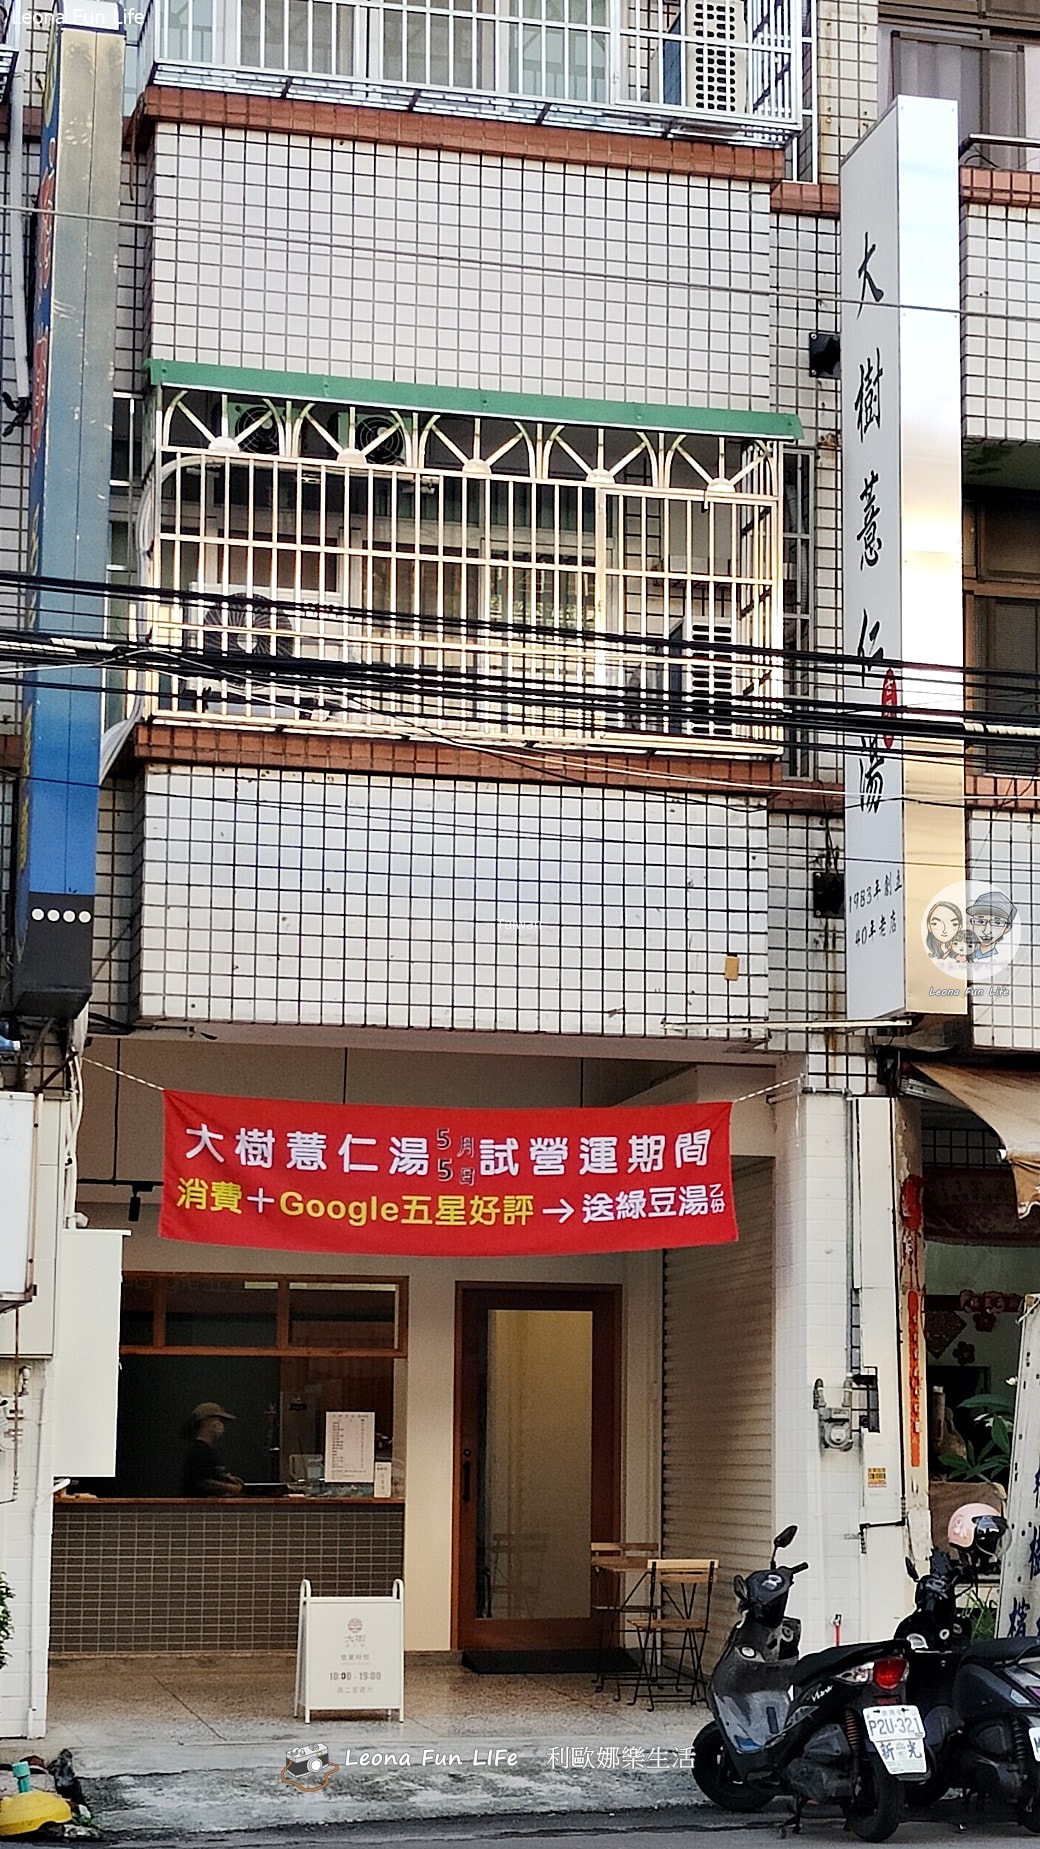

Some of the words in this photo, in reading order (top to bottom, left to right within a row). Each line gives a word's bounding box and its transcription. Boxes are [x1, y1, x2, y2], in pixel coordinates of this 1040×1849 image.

[855, 910, 897, 947] 40年老店
[185, 1123, 430, 1176] 大樹薏仁湯
[479, 1128, 711, 1177] 試營運期間
